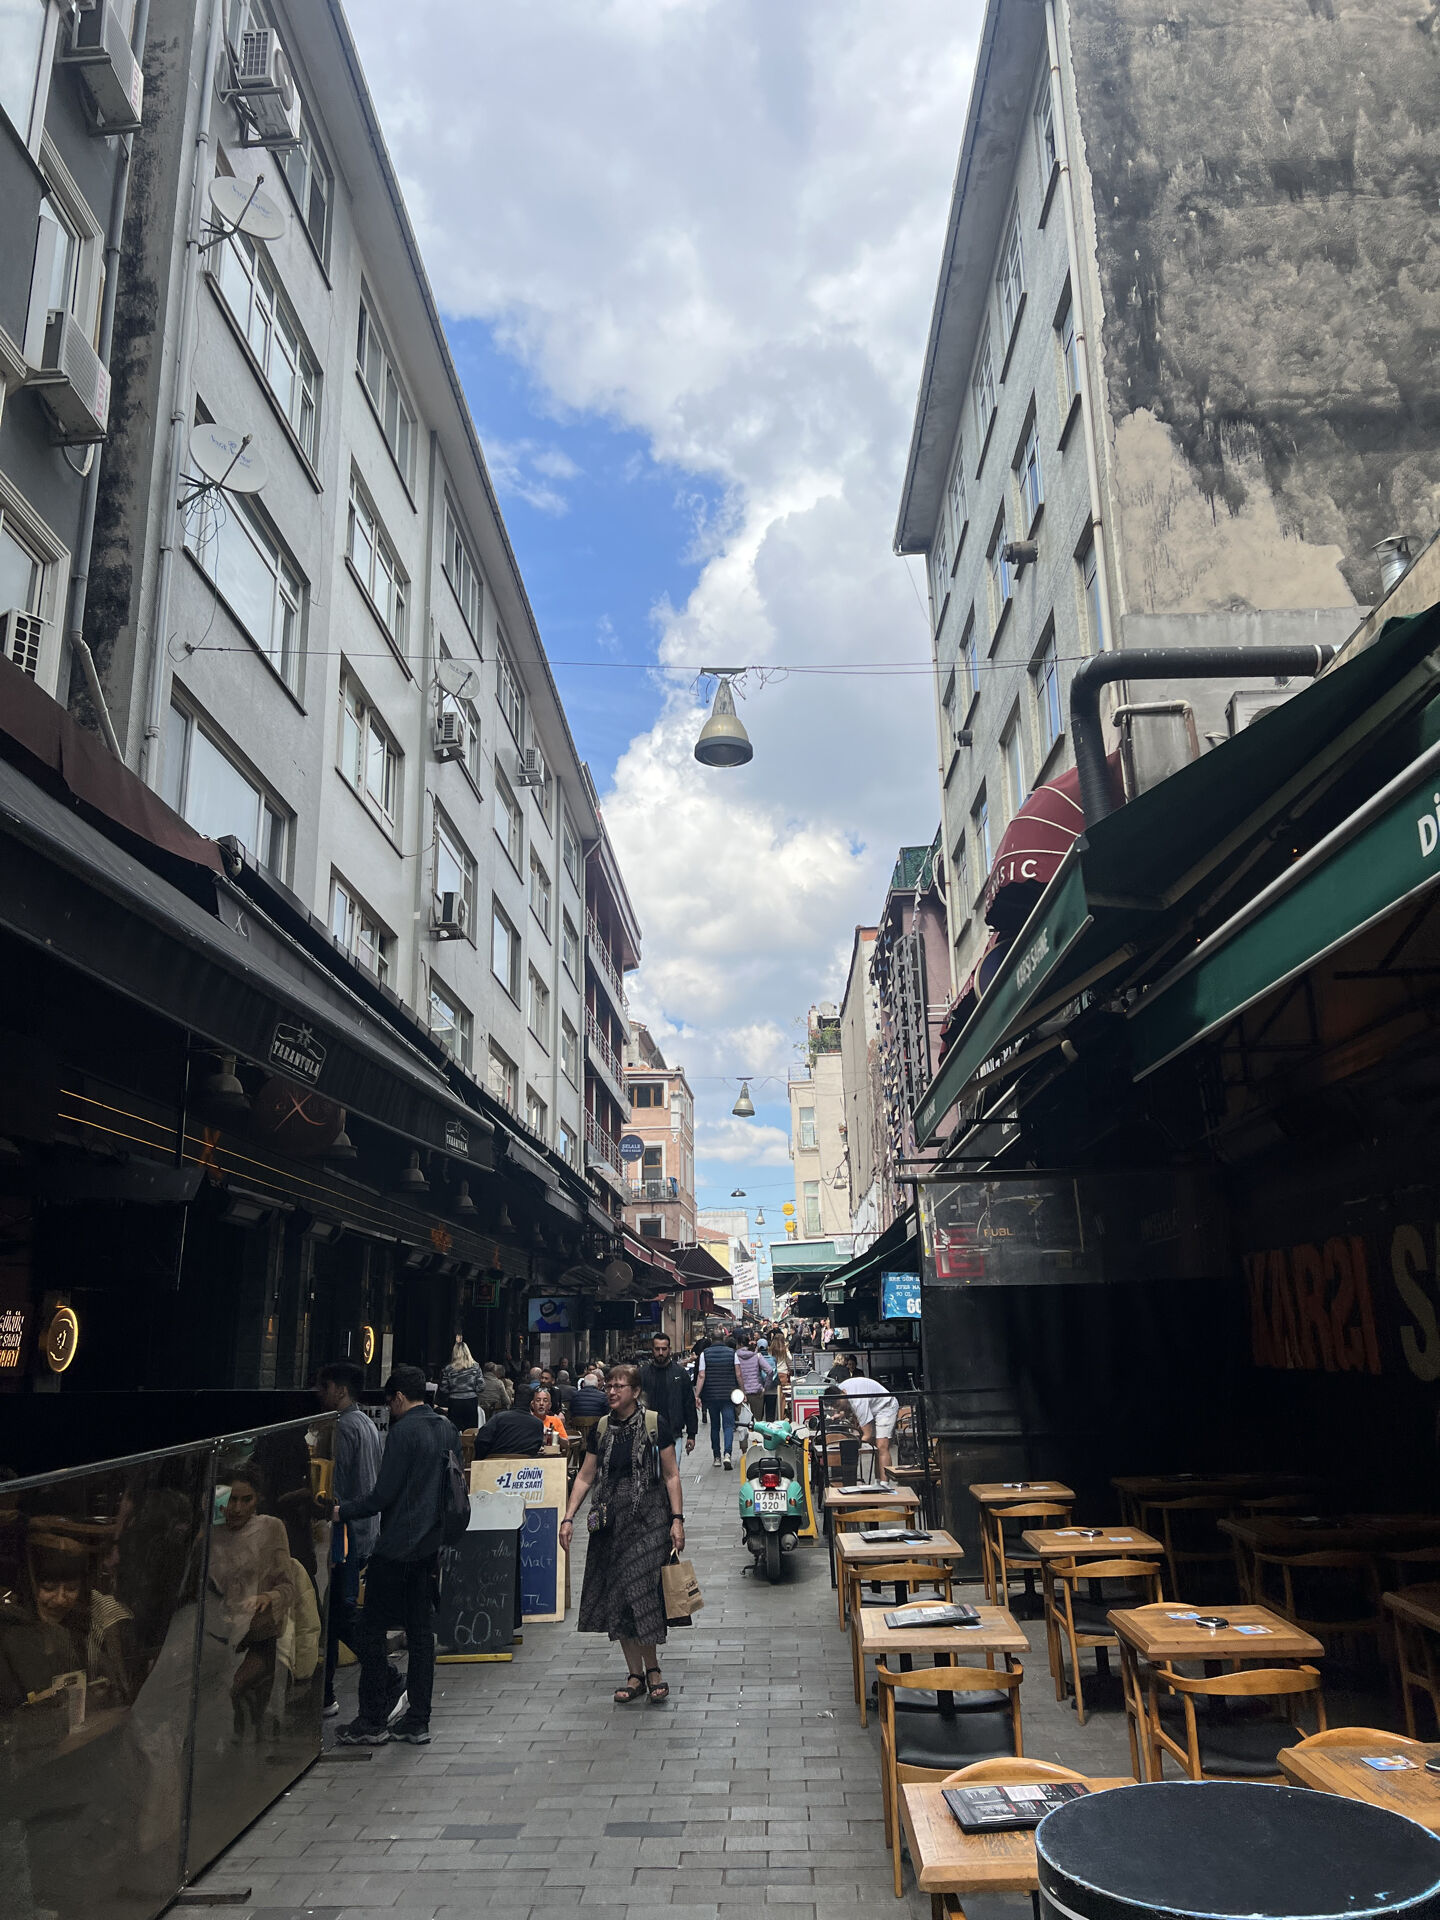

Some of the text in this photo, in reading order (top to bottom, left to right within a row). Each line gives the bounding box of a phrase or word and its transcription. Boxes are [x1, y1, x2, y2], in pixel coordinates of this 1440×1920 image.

[272, 1040, 320, 1077] TARANTULA
[496, 1467, 543, 1488] +1 GÜNÜN
[511, 1479, 543, 1489] HER SAATİ
[755, 1492, 786, 1501] 07 BAH
[762, 1501, 779, 1510] 320
[454, 1610, 492, 1645] 60
